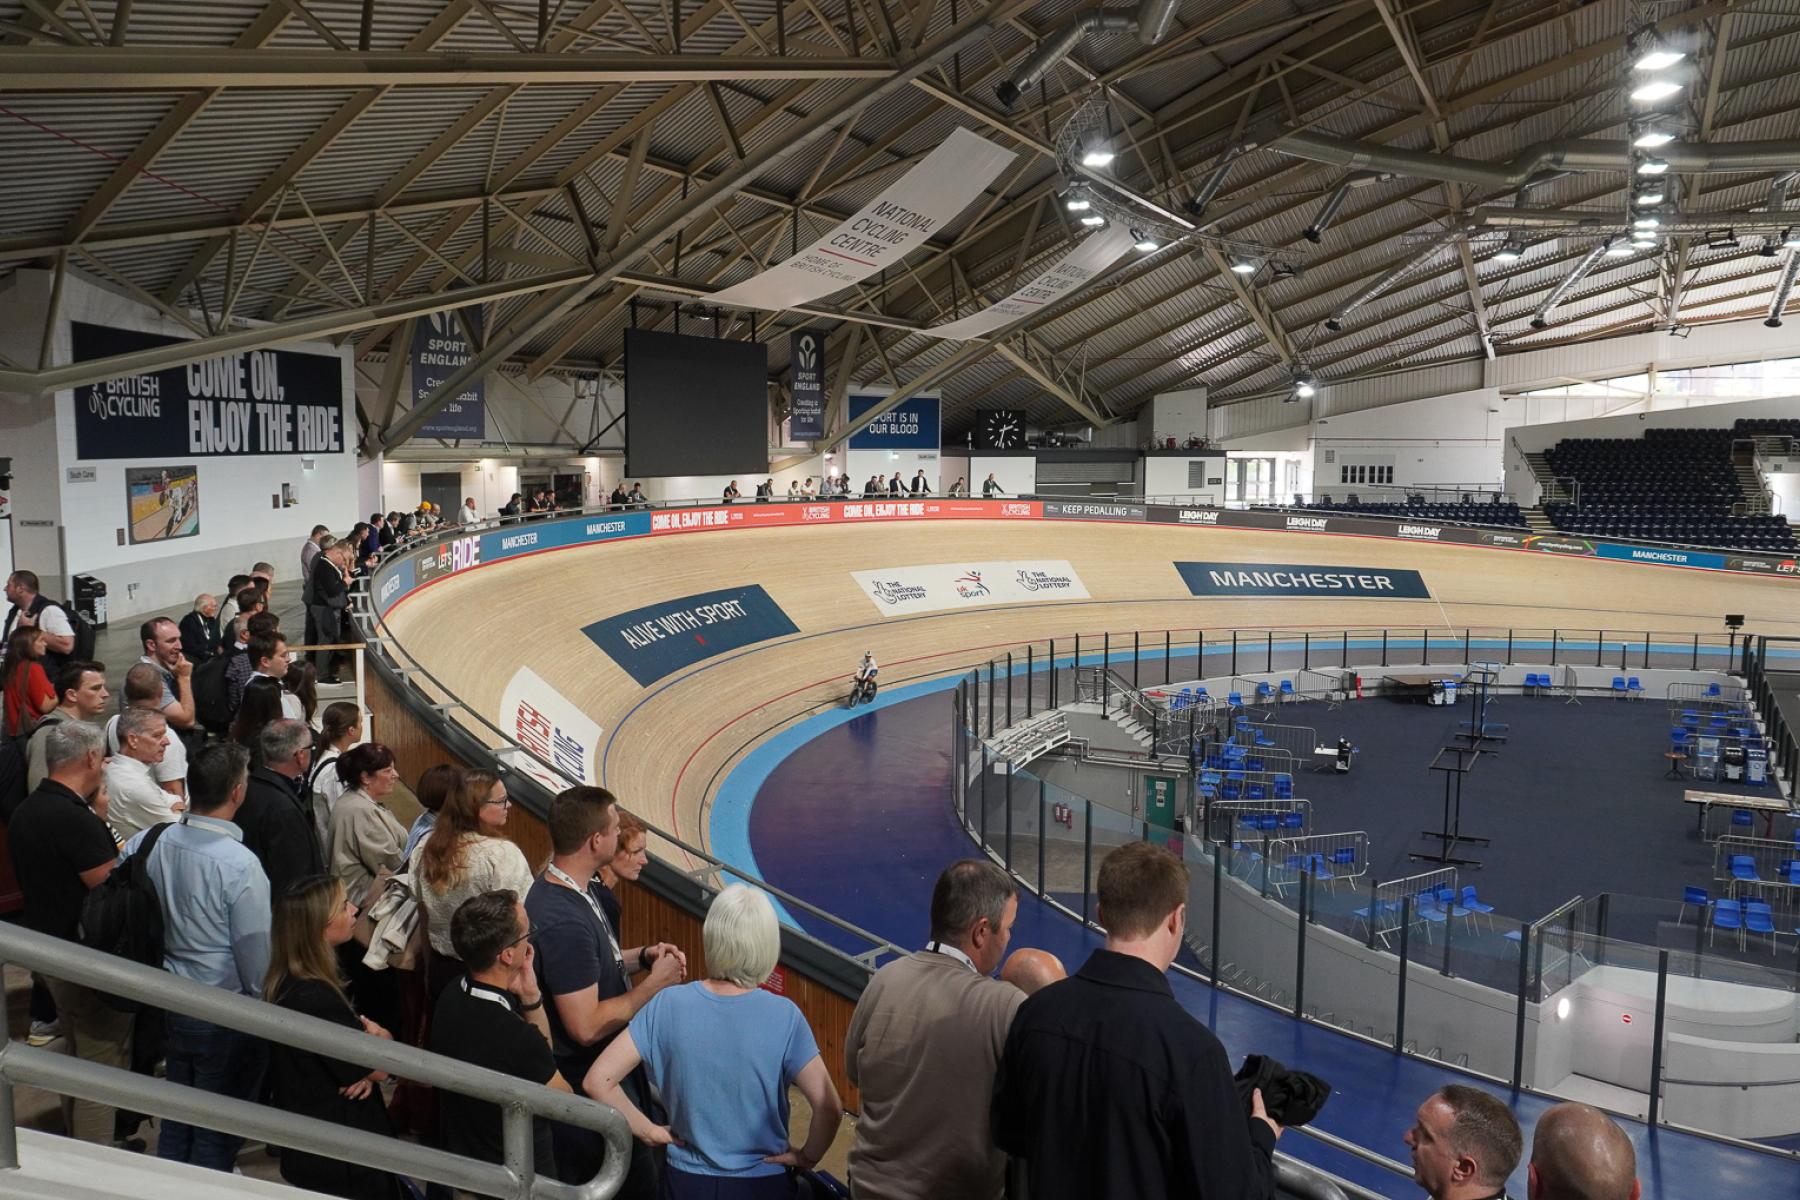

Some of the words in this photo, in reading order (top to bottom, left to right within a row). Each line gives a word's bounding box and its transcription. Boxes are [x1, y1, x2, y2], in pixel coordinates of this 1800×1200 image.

[871, 201, 936, 232] NATIONAL
[851, 218, 909, 245] CYCLING
[830, 233, 887, 258] CENTRE
[428, 339, 466, 353] SPORT
[420, 353, 472, 366] ENGLAN
[187, 352, 247, 399] COME
[250, 350, 285, 401] ON,
[798, 372, 816, 380] SPORT
[107, 376, 160, 397] BRITISH
[107, 396, 161, 418] CYCLING
[900, 413, 907, 423] IS
[910, 413, 918, 423] IN
[188, 400, 250, 453] ENJOY
[256, 403, 293, 451] THE
[297, 404, 340, 451] RIDE
[870, 424, 887, 434] OUR
[890, 424, 919, 434] BLOOD
[844, 504, 863, 518] COME
[897, 503, 909, 516] THE
[1062, 504, 1083, 514] KEEP
[1084, 505, 1128, 517] PEDALLING
[1203, 512, 1219, 520] DAY
[652, 514, 671, 530] COME
[682, 511, 701, 527] ENJOY
[702, 510, 714, 526] THE
[714, 510, 729, 525] RIDE
[1311, 519, 1328, 527] DAY
[587, 521, 626, 536] MANCHESTER
[1424, 527, 1441, 537] DAY
[502, 532, 538, 550] MANCHESTER
[452, 535, 480, 572] RIDE
[1632, 550, 1688, 563] MANCHESTER
[1209, 570, 1395, 591] MANCHESTER
[892, 586, 927, 594] NATIONAL
[896, 592, 926, 602] LOTTERY
[960, 589, 985, 599] sport
[620, 621, 666, 650] ALIVE
[655, 609, 702, 635] WITH
[695, 599, 748, 625] SPORT
[516, 700, 552, 764] RITISH
